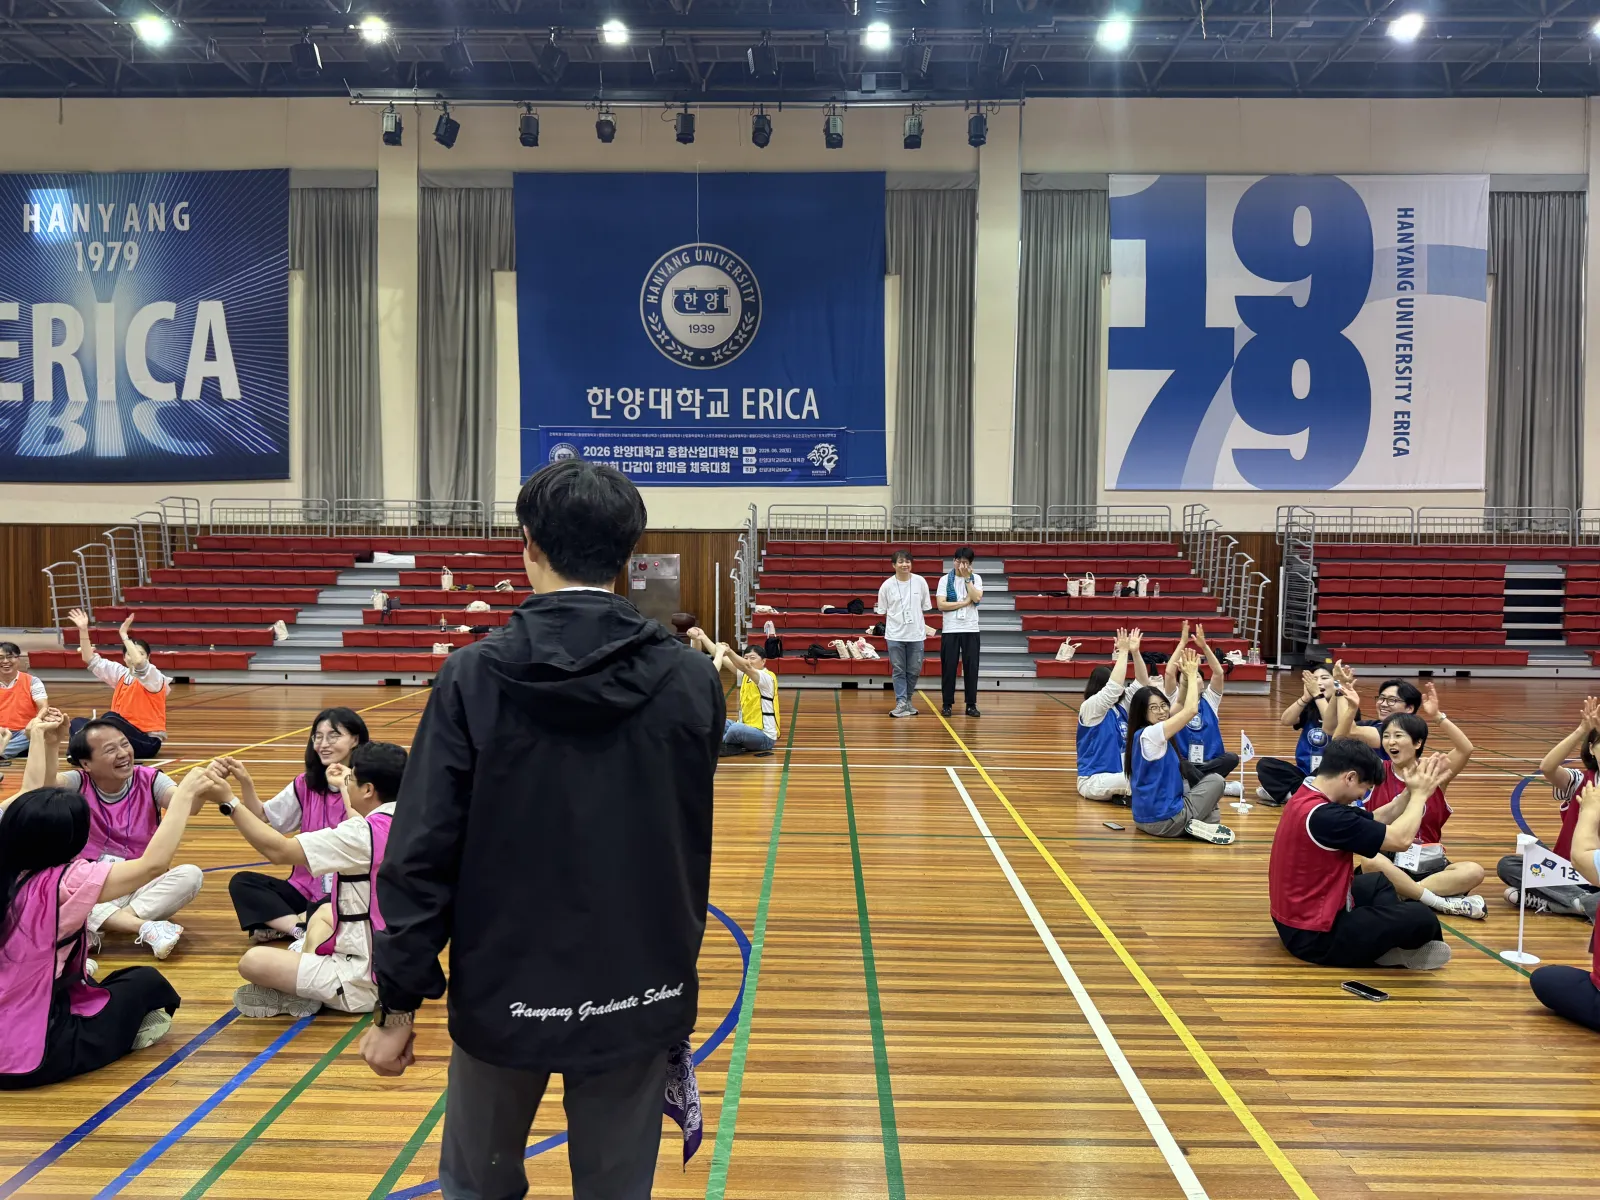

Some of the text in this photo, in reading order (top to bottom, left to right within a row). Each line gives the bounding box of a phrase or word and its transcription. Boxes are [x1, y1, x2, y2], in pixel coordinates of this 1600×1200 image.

[23, 200, 190, 233] HANYANG
[74, 240, 140, 272] 1979
[646, 249, 756, 304] HANYANG UNIVERSITY
[688, 324, 715, 334] 1939
[1392, 207, 1414, 458] HANYANG UNIVERSITY ERICA
[586, 387, 820, 421] 한양대학교 ERICA
[583, 446, 611, 457] 2026
[613, 446, 665, 458] 한양대학교
[667, 446, 739, 459] 융합산업대학원
[656, 461, 687, 474] 한마음
[689, 461, 731, 474] 체육대회
[509, 982, 685, 1022] Hanyang Graduate School
